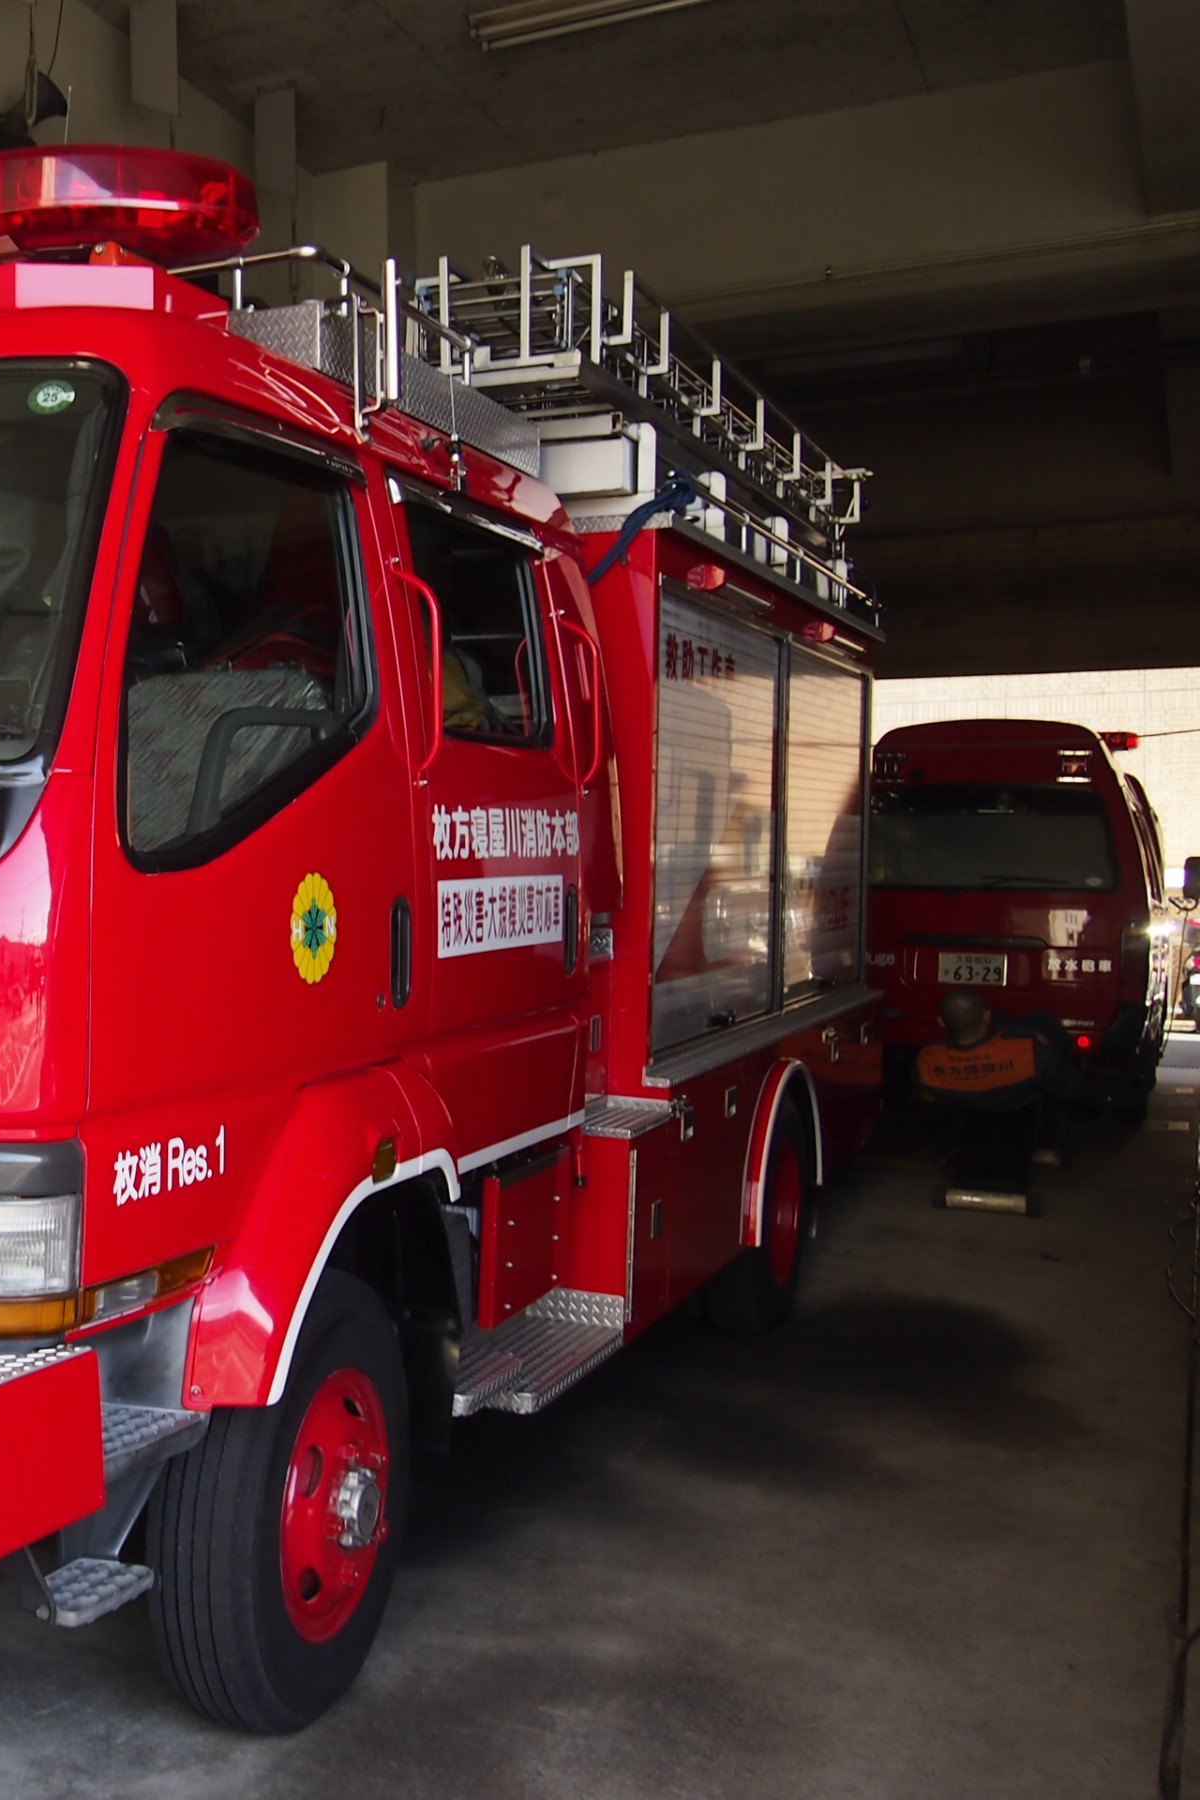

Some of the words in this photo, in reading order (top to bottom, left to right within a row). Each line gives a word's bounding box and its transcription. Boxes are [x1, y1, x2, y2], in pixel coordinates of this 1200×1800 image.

[432, 804, 580, 861] 枚方寝屋川消防本部
[292, 919, 303, 942] H
[325, 914, 336, 937] N
[112, 1142, 162, 1207] 枚消
